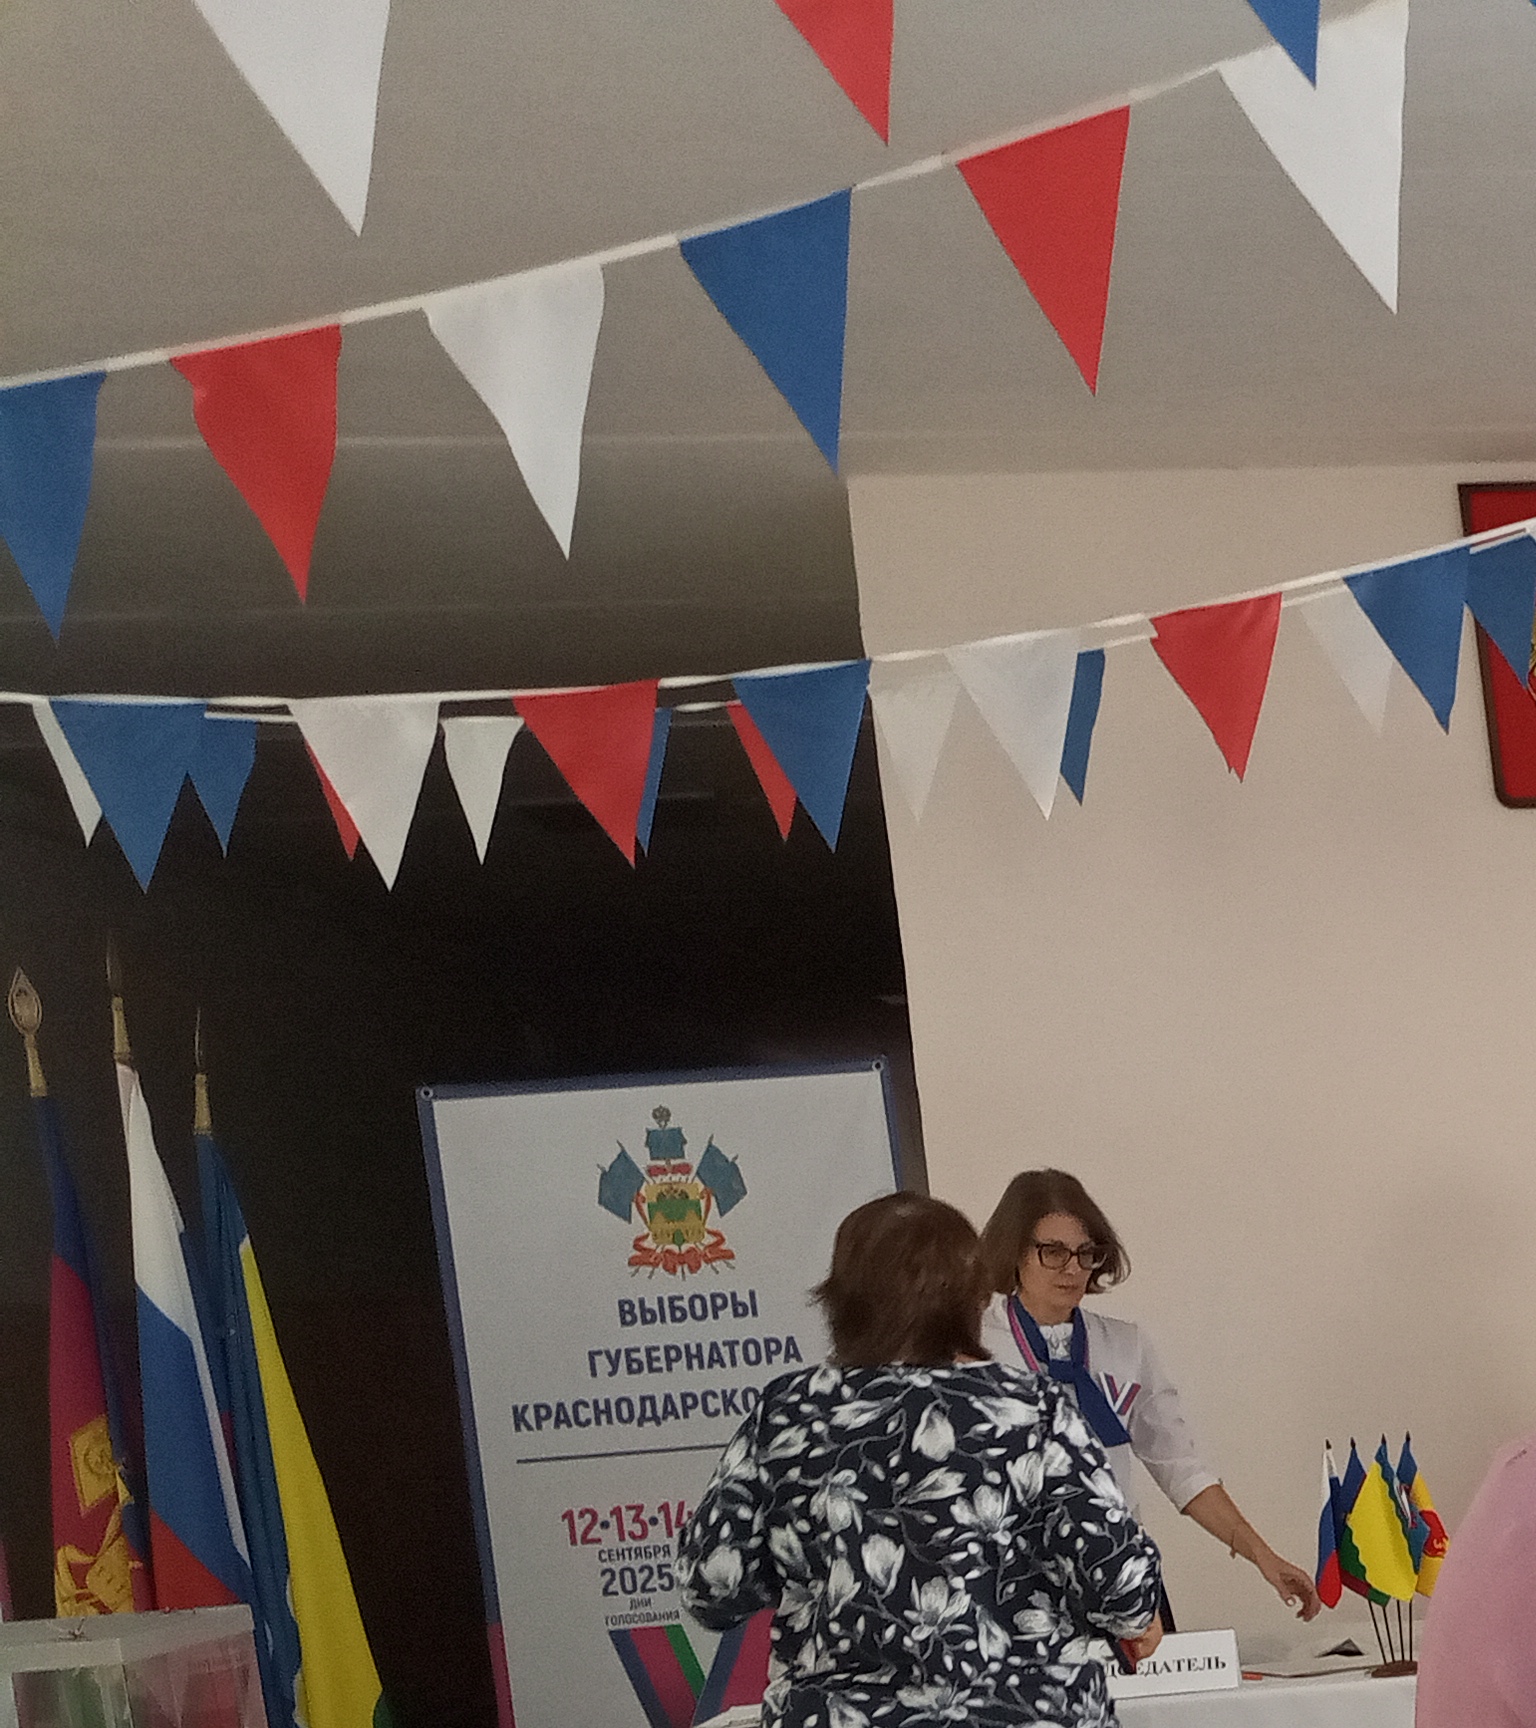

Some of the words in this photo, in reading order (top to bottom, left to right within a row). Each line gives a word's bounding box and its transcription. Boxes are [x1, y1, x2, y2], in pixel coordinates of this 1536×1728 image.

[617, 1289, 759, 1328] ВЫБОРЫ
[587, 1335, 803, 1378] ГУБЕРНАТОРА
[511, 1386, 762, 1433] КРАСНОДАРСКО
[598, 1544, 671, 1563] СЕНТЯБРЯ
[600, 1563, 675, 1597] 2025
